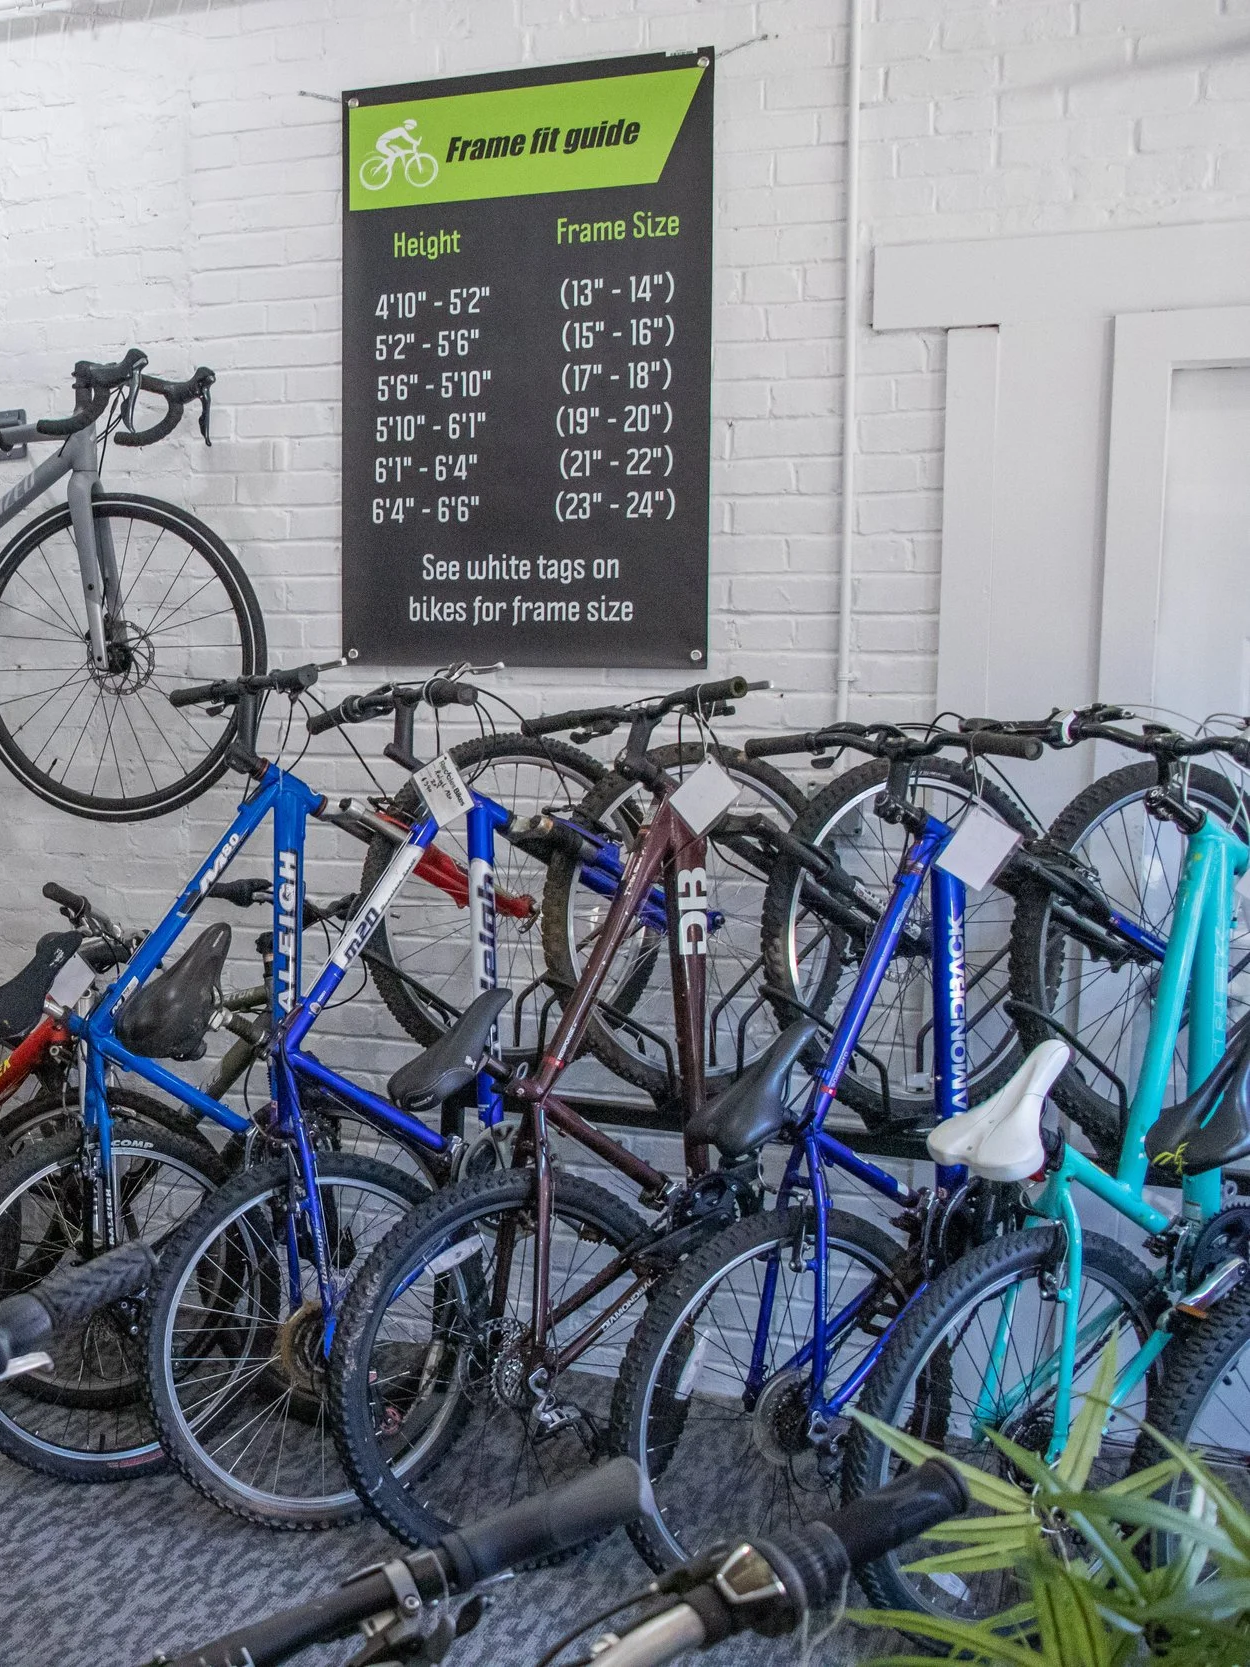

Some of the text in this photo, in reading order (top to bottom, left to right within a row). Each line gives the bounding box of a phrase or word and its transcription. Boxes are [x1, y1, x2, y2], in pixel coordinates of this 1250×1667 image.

[446, 118, 640, 163] Frame fit guide
[556, 211, 680, 245] Frame Size
[393, 230, 461, 261] Height
[375, 291, 427, 320] 4'10"
[449, 286, 490, 315] 5'2"
[560, 278, 604, 310] (13"
[629, 271, 676, 304] 14")
[375, 332, 415, 360] 5'2"
[437, 329, 480, 357] 5'6"
[561, 320, 605, 352] (15"
[630, 314, 676, 347] 16")
[377, 373, 419, 402] 5'6"
[441, 370, 491, 398] 5'10"
[561, 363, 602, 395] (17"
[628, 358, 672, 390] 18")
[376, 415, 425, 442] 5'10"
[448, 411, 486, 439] 6'1"
[556, 406, 600, 437] (19"
[624, 401, 673, 433] 20")
[375, 457, 412, 483] 6'1"
[435, 454, 478, 481] 6'4"
[559, 449, 602, 480] (21"
[626, 445, 674, 477] 22")
[372, 497, 414, 524] 6'4"
[437, 495, 480, 523] 6'6"
[555, 491, 602, 522] (23"
[626, 488, 676, 520] 24")
[422, 554, 620, 584] See white tags on
[409, 595, 634, 626] bikes for frame size
[278, 850, 298, 1014] ALEIGH
[948, 914, 967, 1116] AMONDBACK
[105, 1188, 116, 1246] RALEIGH
